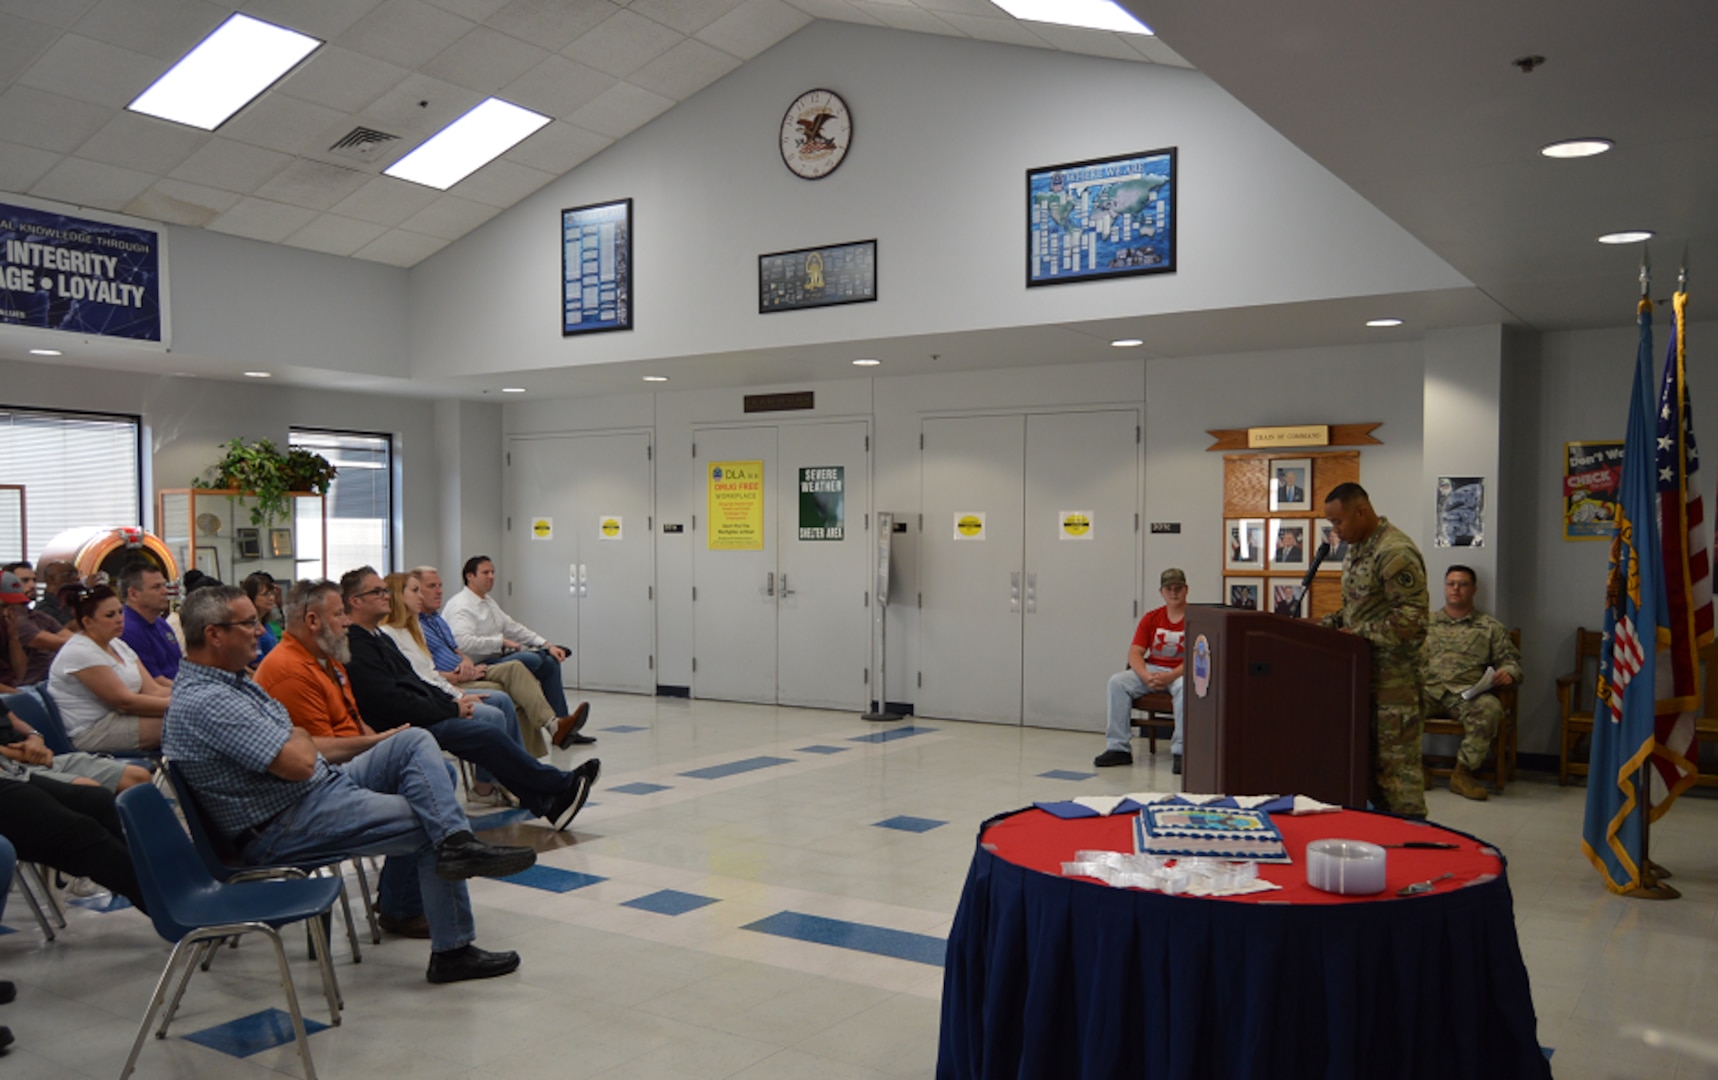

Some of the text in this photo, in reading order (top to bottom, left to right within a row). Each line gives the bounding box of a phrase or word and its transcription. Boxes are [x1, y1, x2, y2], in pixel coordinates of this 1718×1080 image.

[19, 223, 92, 244] KNOWLEDGE
[97, 236, 149, 253] THROUGH
[6, 239, 118, 279] INTEGRITY
[58, 273, 145, 309] LOYALTY
[725, 469, 745, 480] DLA
[805, 468, 838, 481] SEVERE
[1567, 470, 1612, 487] CHECK
[714, 482, 759, 491] DRUG FREE
[801, 480, 842, 493] WEATHER
[715, 492, 756, 500] WORKPLACE
[799, 527, 843, 539] SHELTER AREA
